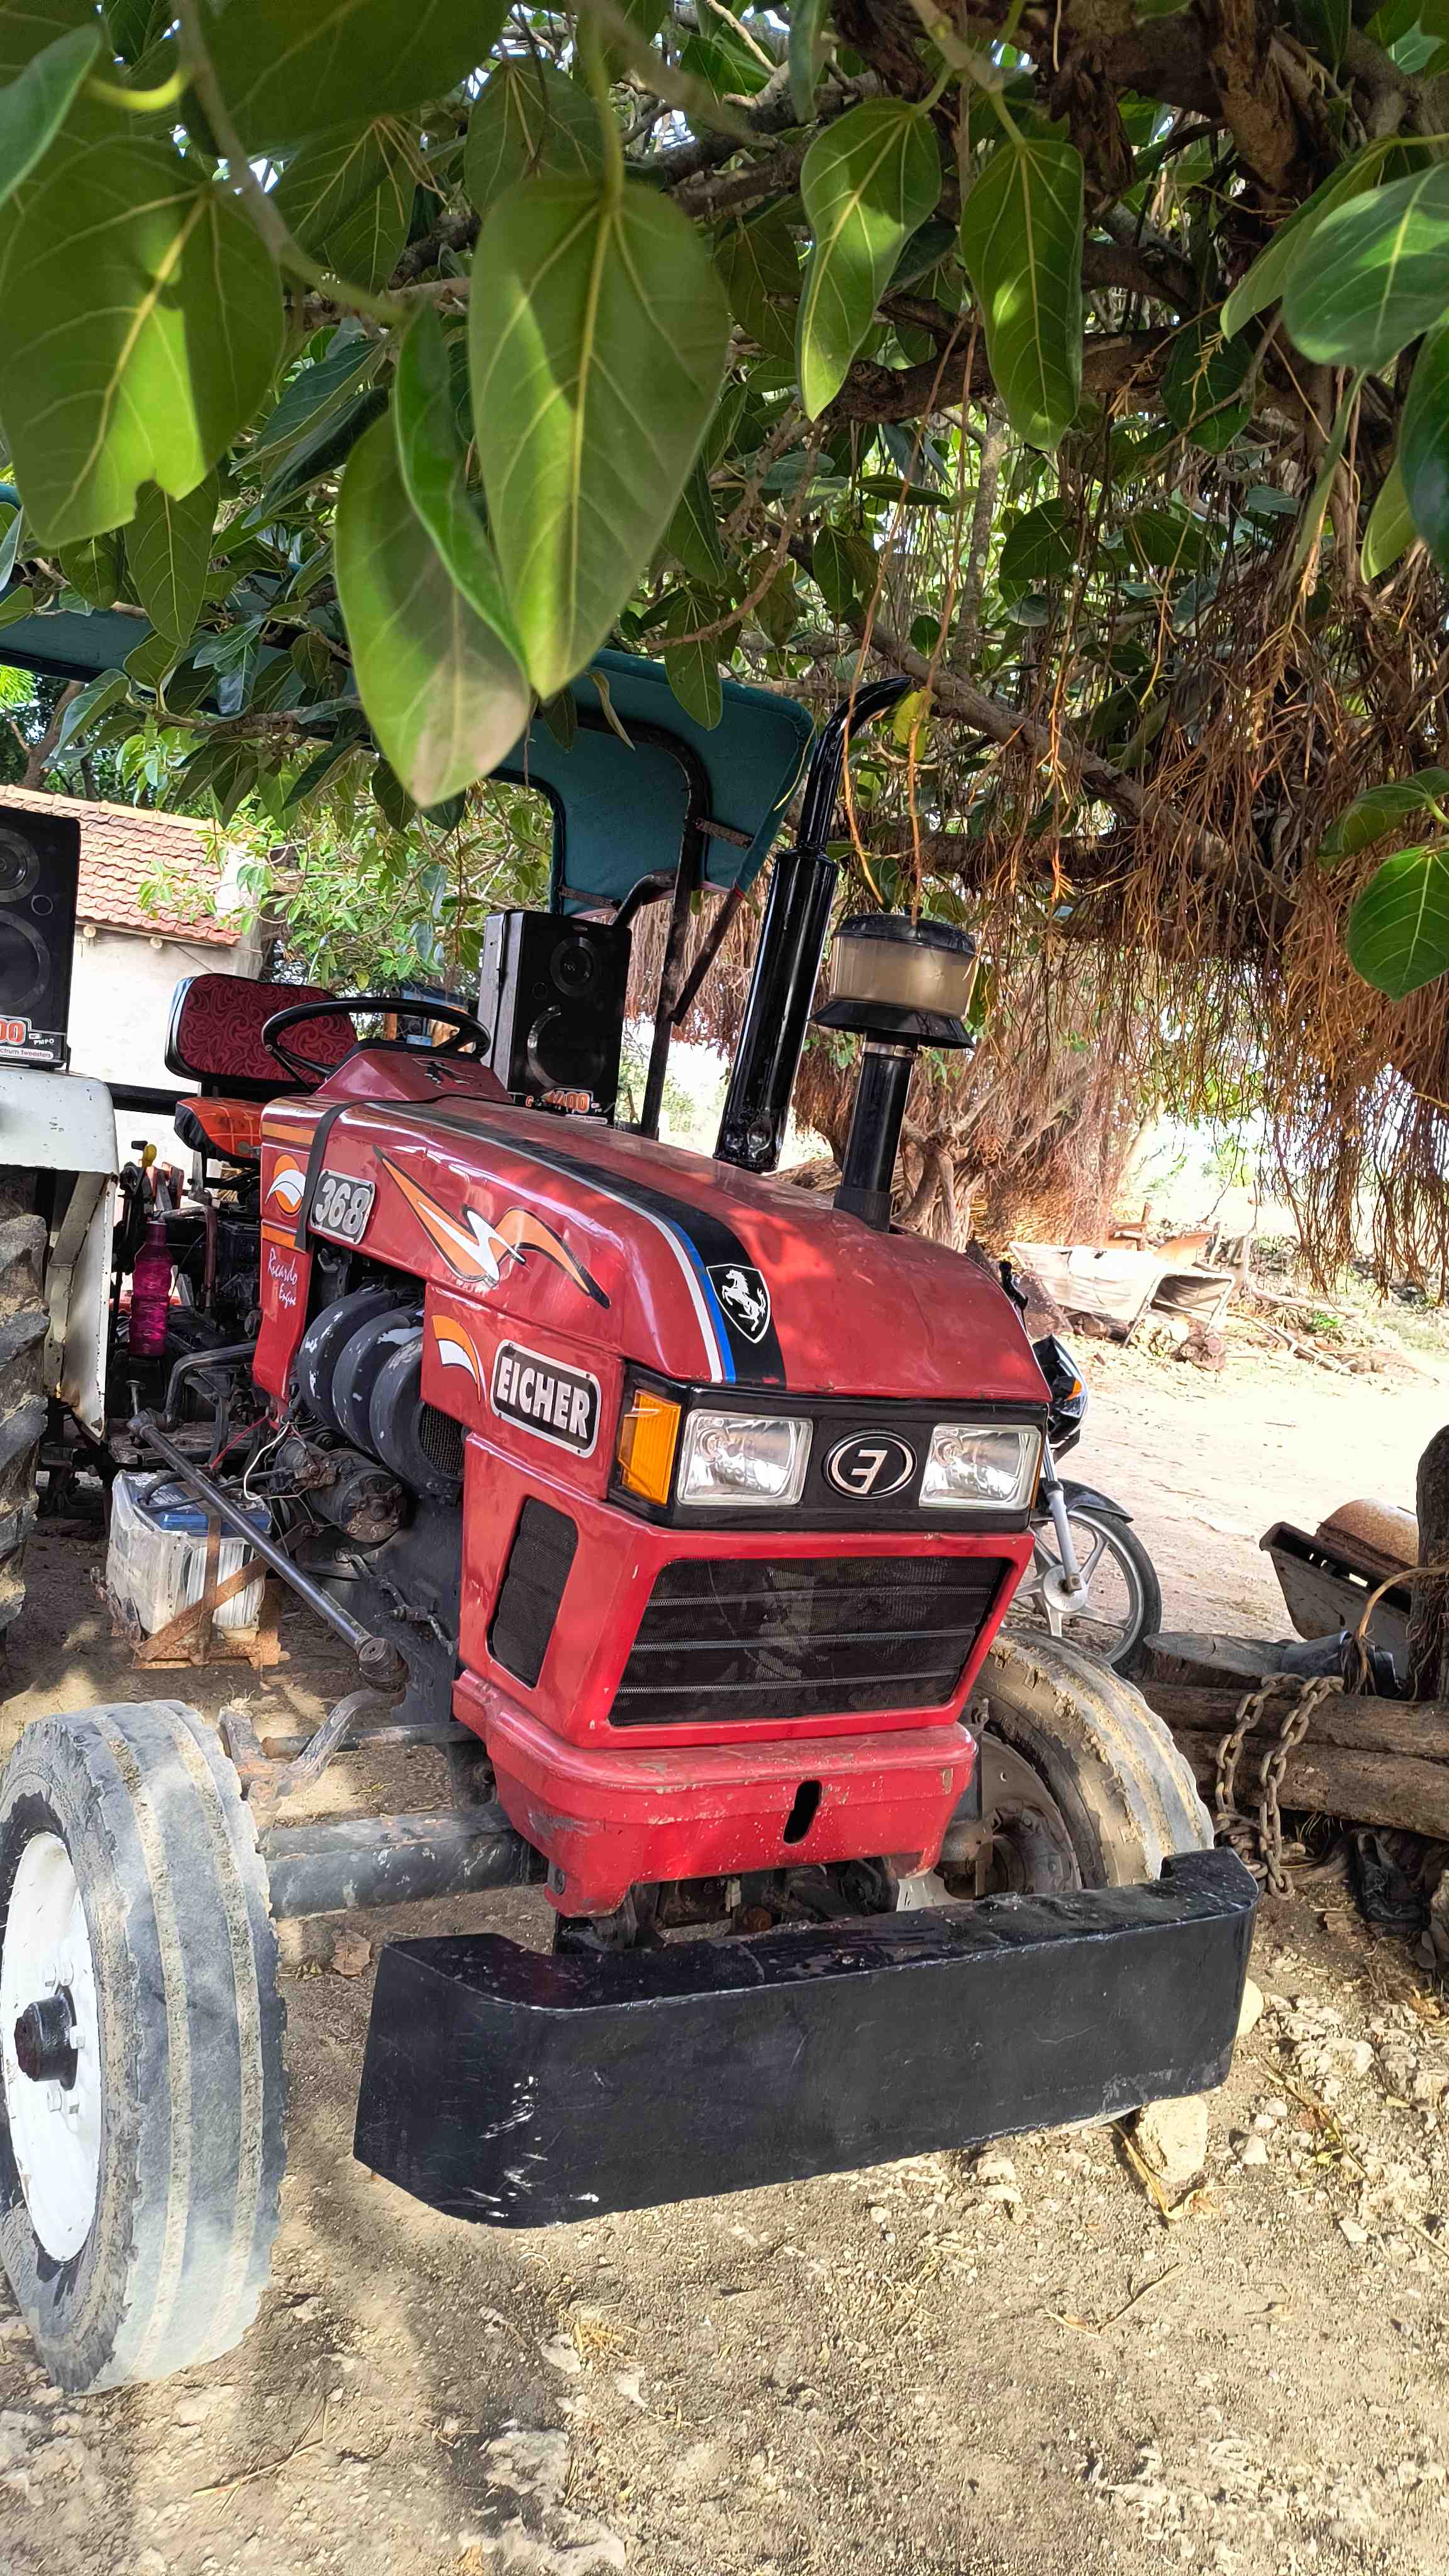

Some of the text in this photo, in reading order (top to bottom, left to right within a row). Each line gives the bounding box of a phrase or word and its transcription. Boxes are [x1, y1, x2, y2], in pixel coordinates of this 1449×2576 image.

[315, 1179, 370, 1234] 368
[267, 1248, 297, 1285] Ricardo
[496, 1356, 590, 1439] EICHER
